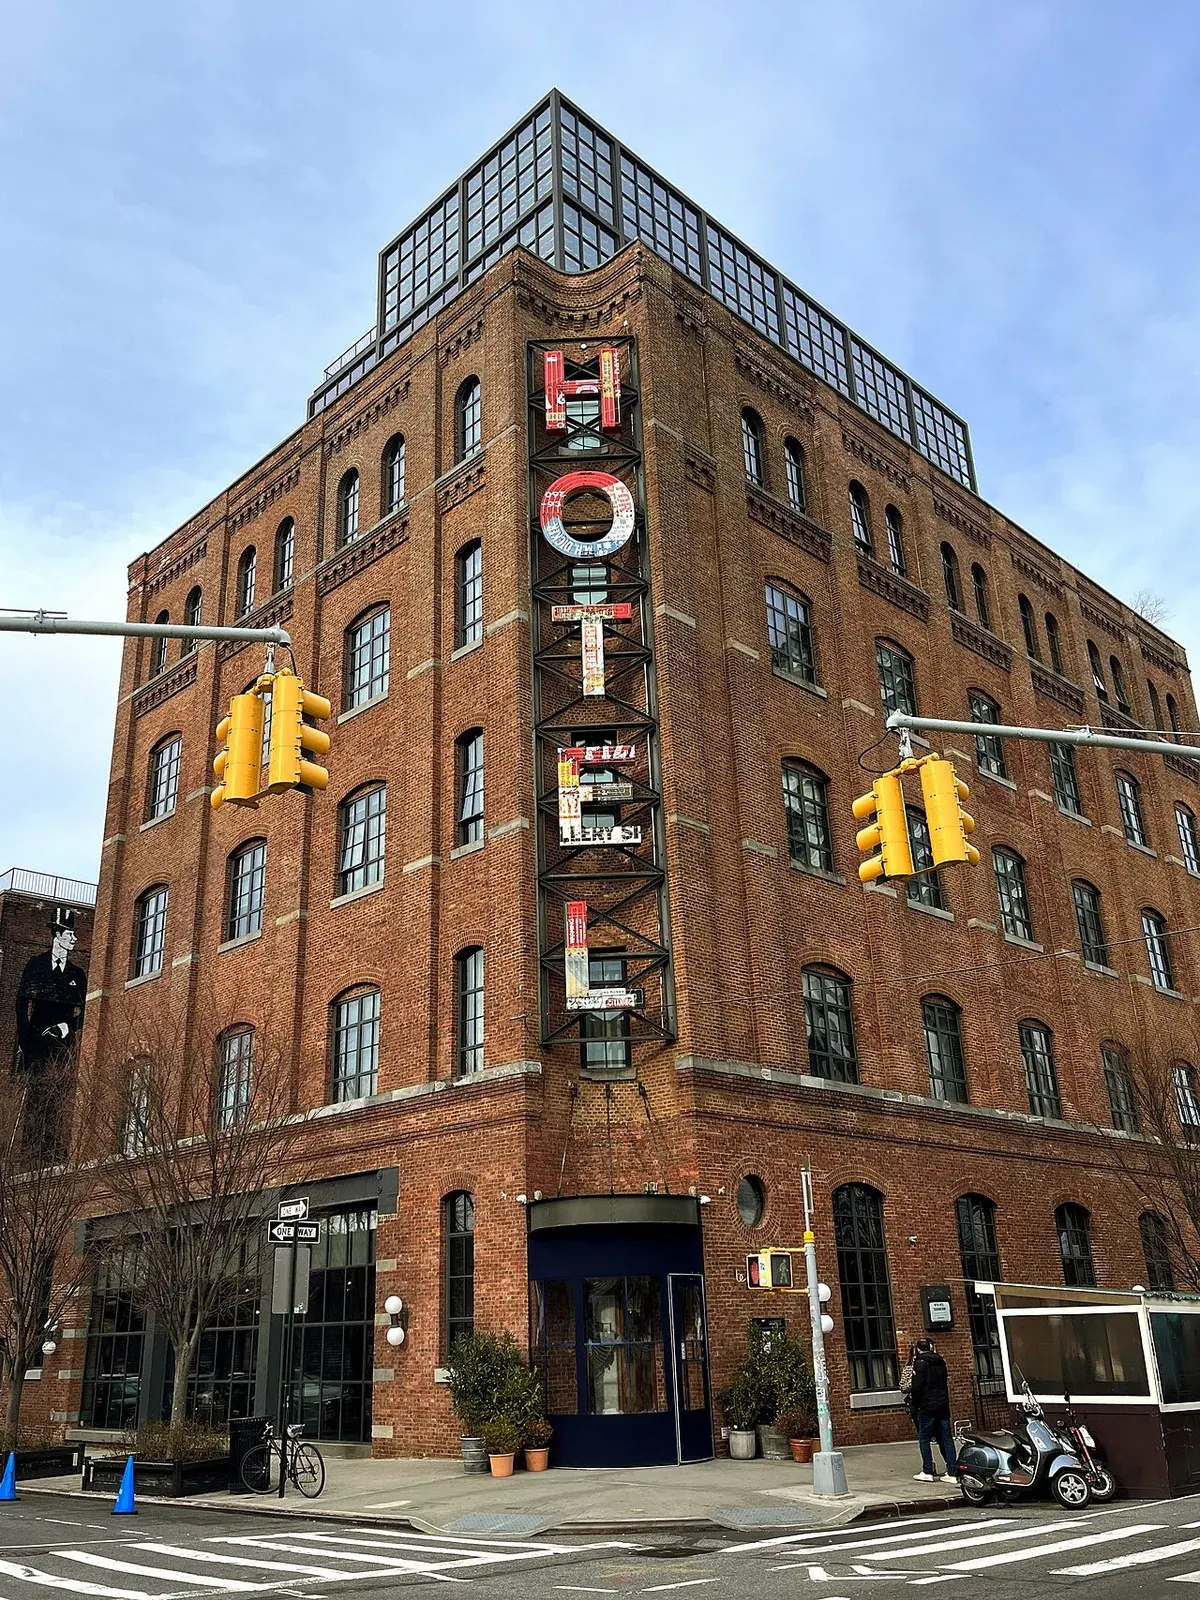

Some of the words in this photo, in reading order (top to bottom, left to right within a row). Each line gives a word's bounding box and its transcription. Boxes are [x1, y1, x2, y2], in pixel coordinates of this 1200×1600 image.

[541, 348, 643, 1011] HOTEL
[277, 1227, 292, 1236] ONE
[297, 1228, 313, 1236] WAY
